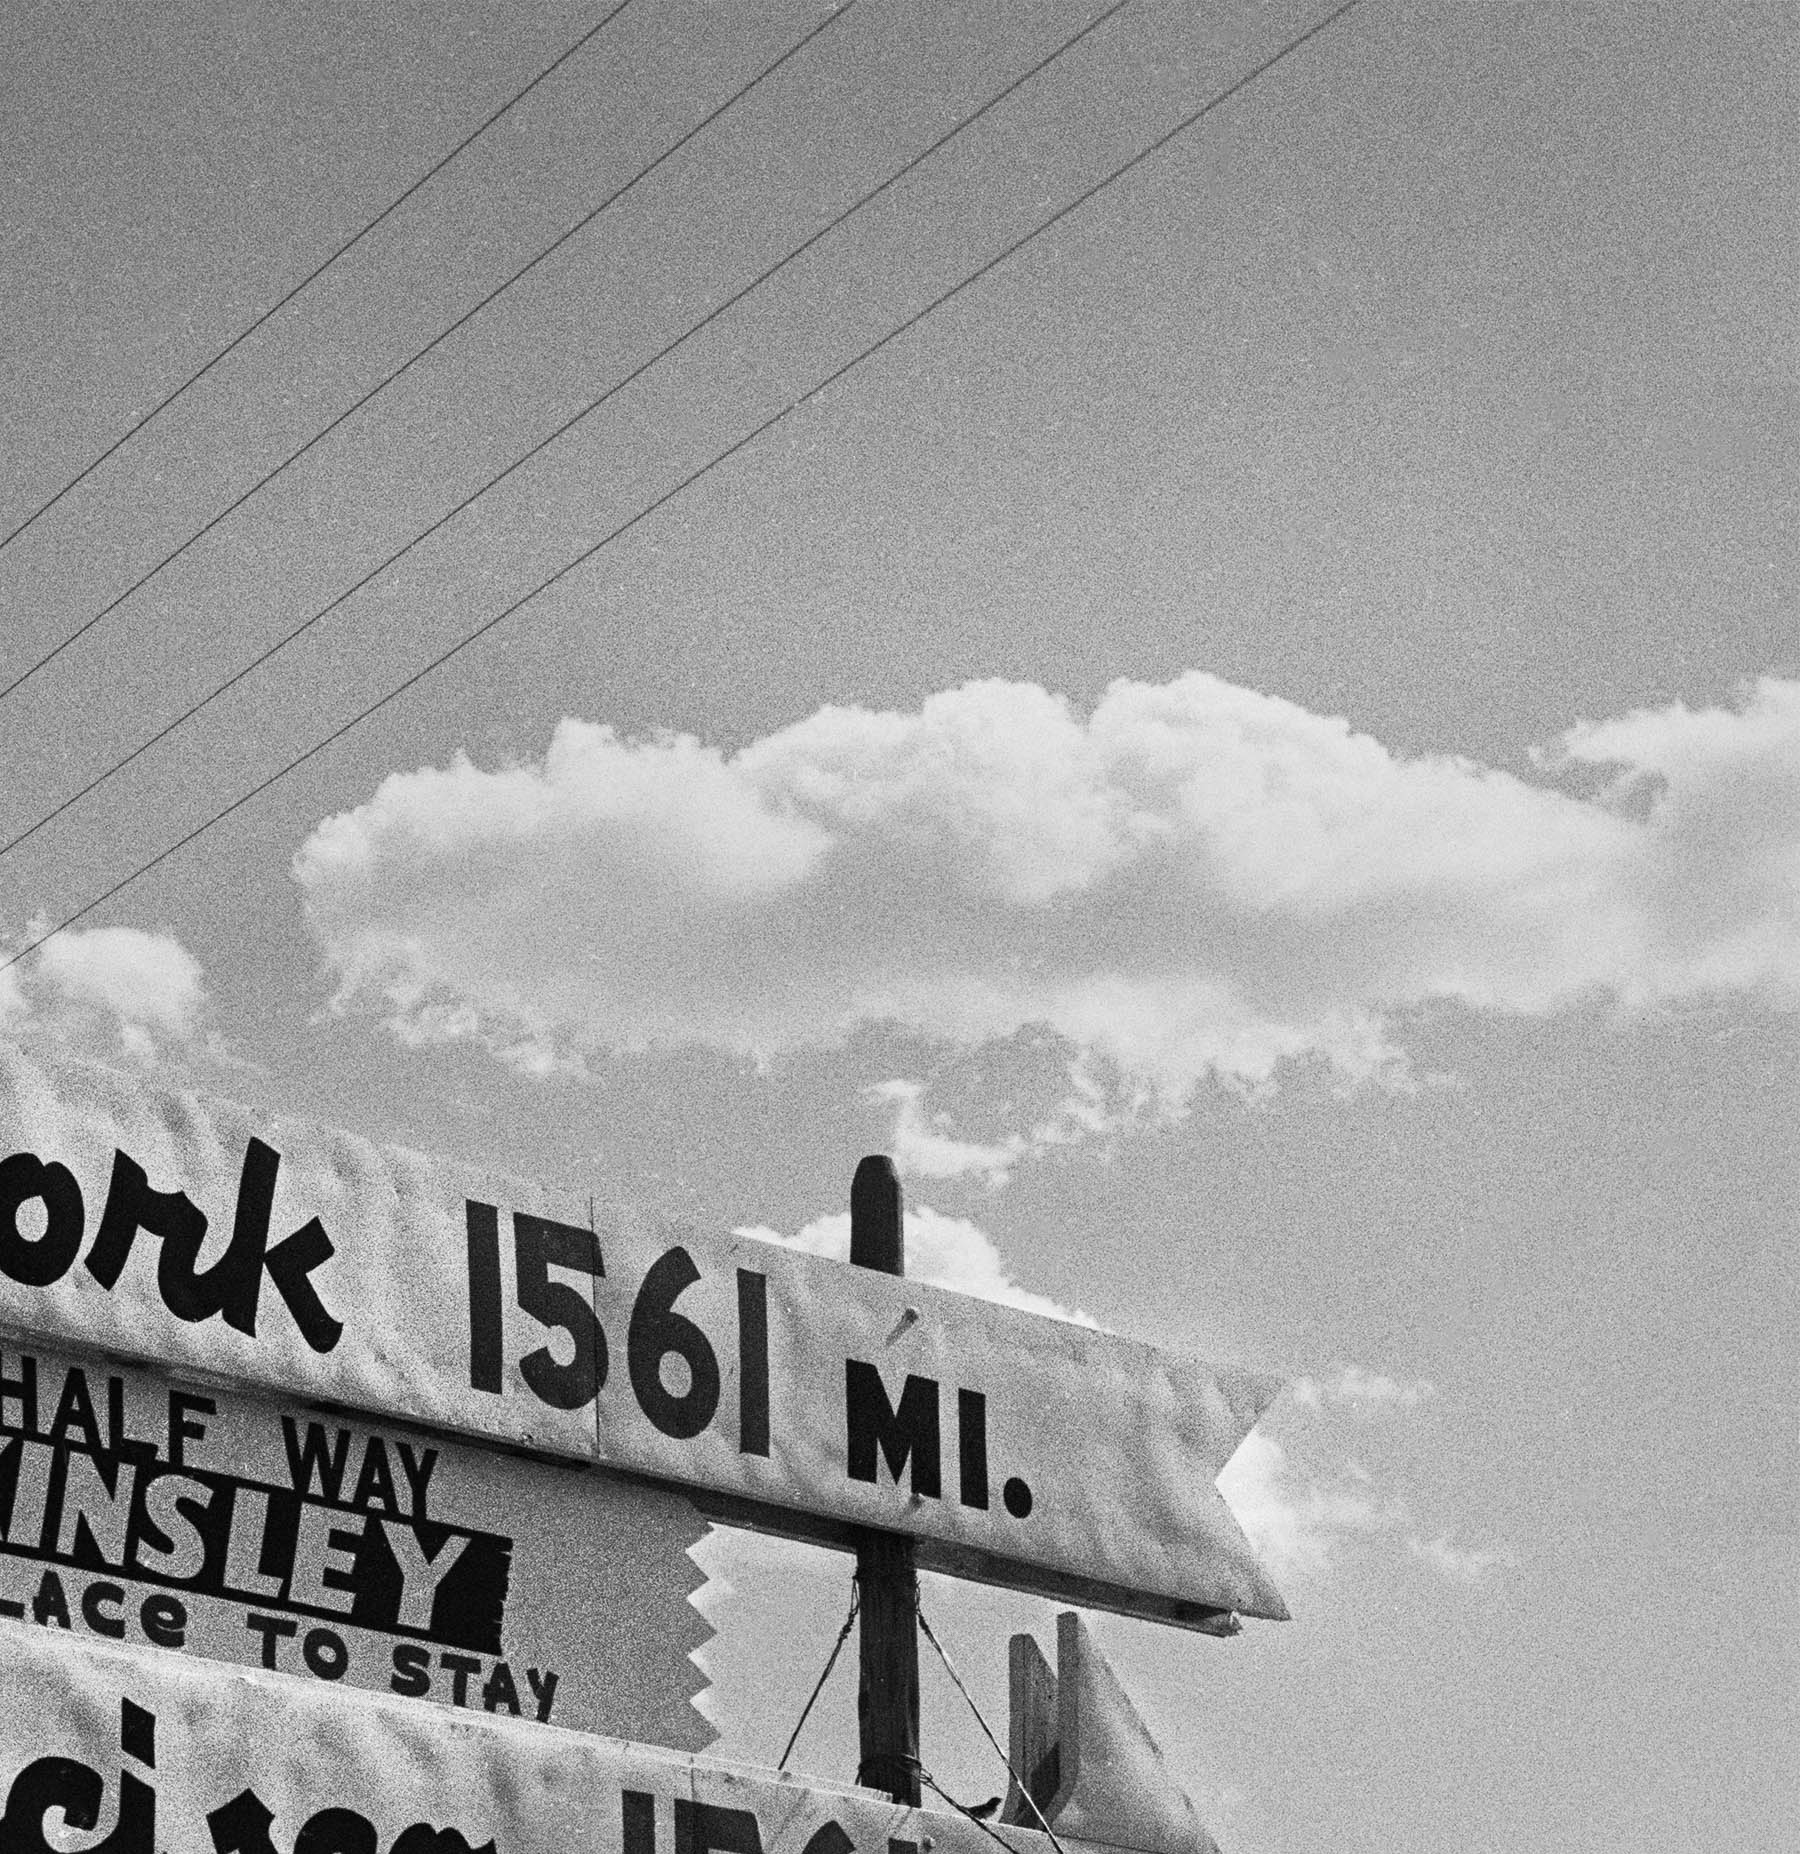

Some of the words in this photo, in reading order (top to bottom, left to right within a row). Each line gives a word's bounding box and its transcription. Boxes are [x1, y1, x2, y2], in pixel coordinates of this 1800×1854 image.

[466, 1199, 770, 1458] 1561
[845, 1358, 1032, 1520] MI.
[281, 1415, 439, 1520] WAY
[247, 1613, 351, 1681] TO
[391, 1644, 560, 1724] STAY
